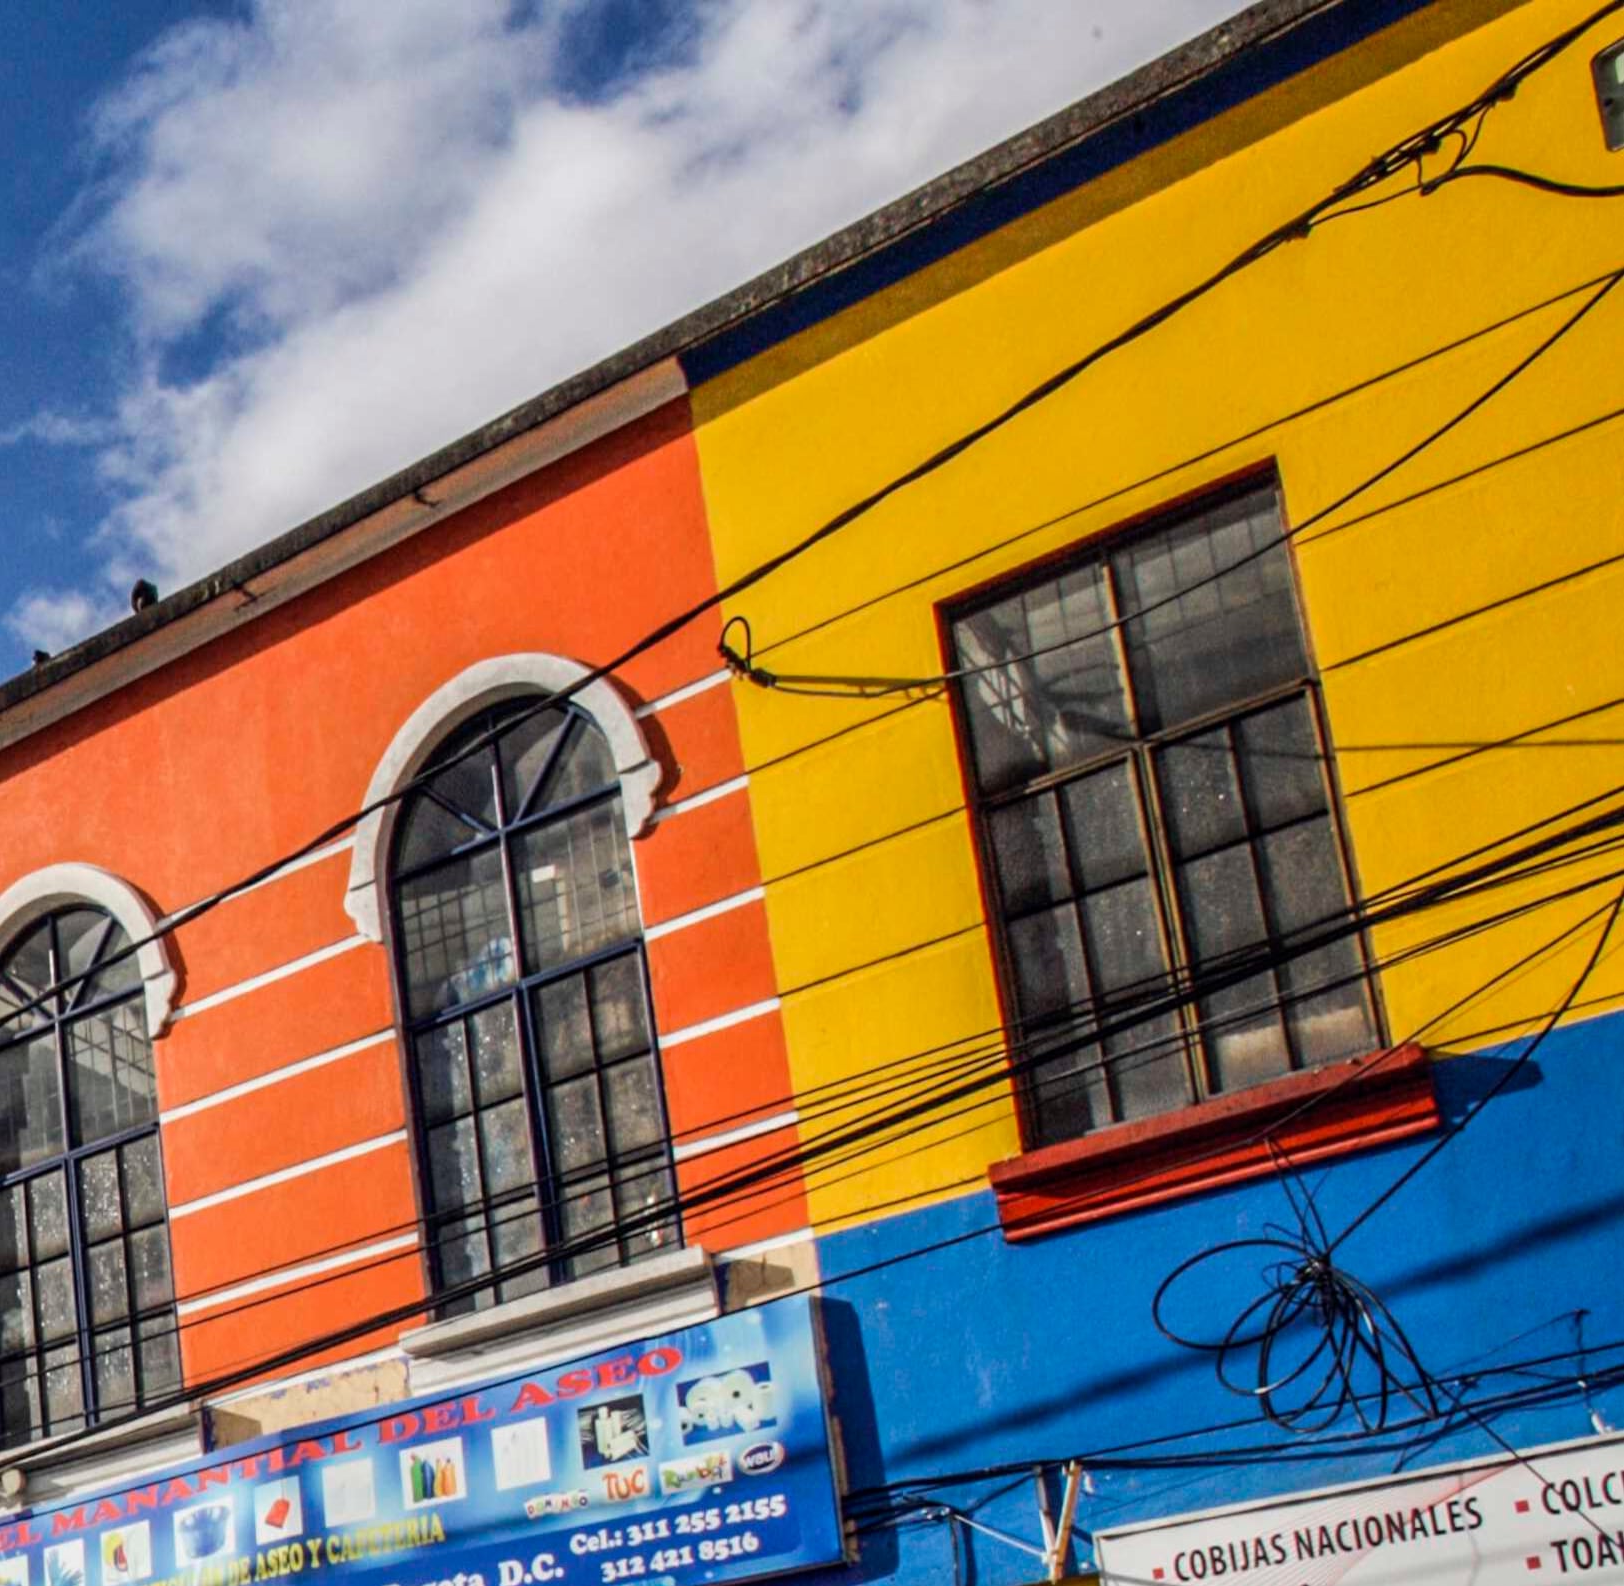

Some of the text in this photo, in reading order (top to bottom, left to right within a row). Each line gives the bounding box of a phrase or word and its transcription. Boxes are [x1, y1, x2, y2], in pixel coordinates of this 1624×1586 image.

[52, 1430, 362, 1535] MANANTIAL
[378, 1394, 495, 1444] DEL
[509, 1346, 683, 1412] ASEO
[569, 1494, 787, 1555] Cel.: 311 255 2155
[1541, 1469, 1624, 1515] COLC
[255, 1542, 304, 1582] ASEO
[306, 1537, 322, 1568] Y
[326, 1512, 445, 1563] CAFETERIA
[601, 1531, 760, 1583] 312 421 8516
[1174, 1496, 1483, 1583] COBIJAS NACIONALES
